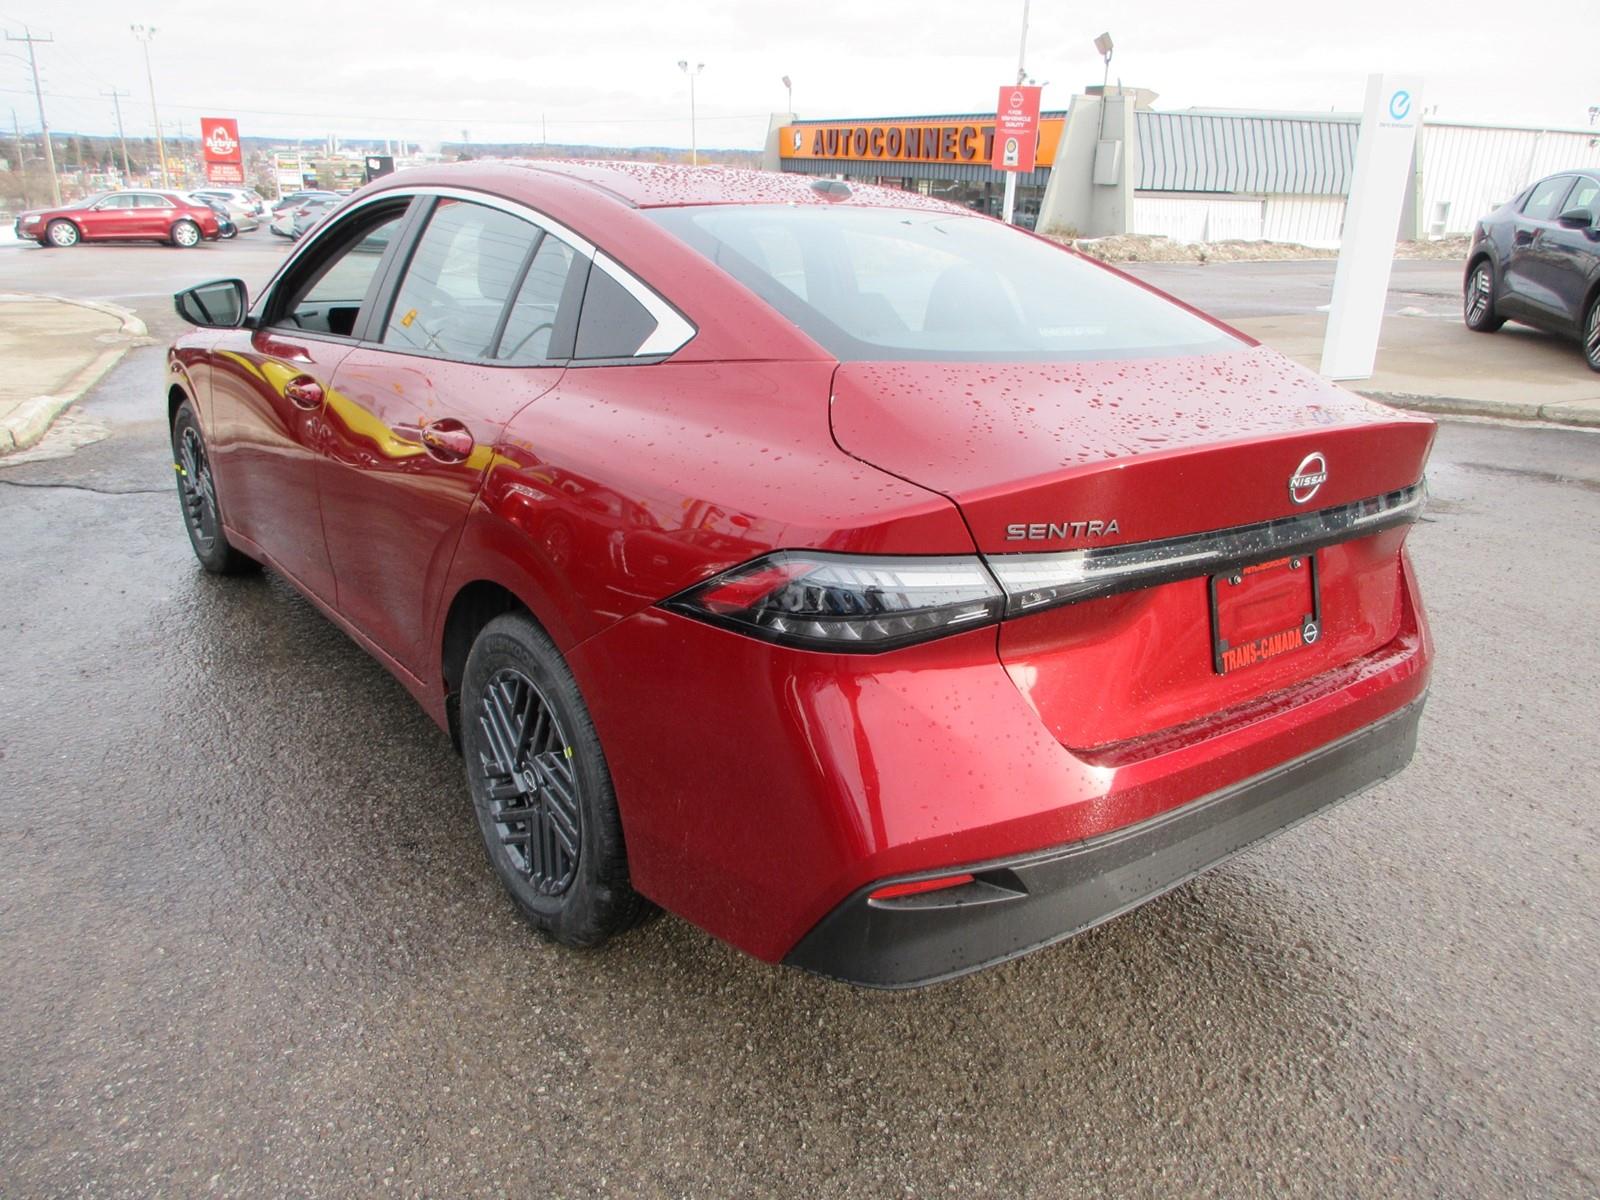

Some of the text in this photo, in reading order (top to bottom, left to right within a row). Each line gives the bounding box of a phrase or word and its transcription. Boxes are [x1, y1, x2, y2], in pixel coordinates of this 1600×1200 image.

[812, 126, 1040, 161] AUTOCONNECT
[1006, 519, 1120, 540] SENTRA
[1222, 628, 1303, 672] TRANS-CANADA
